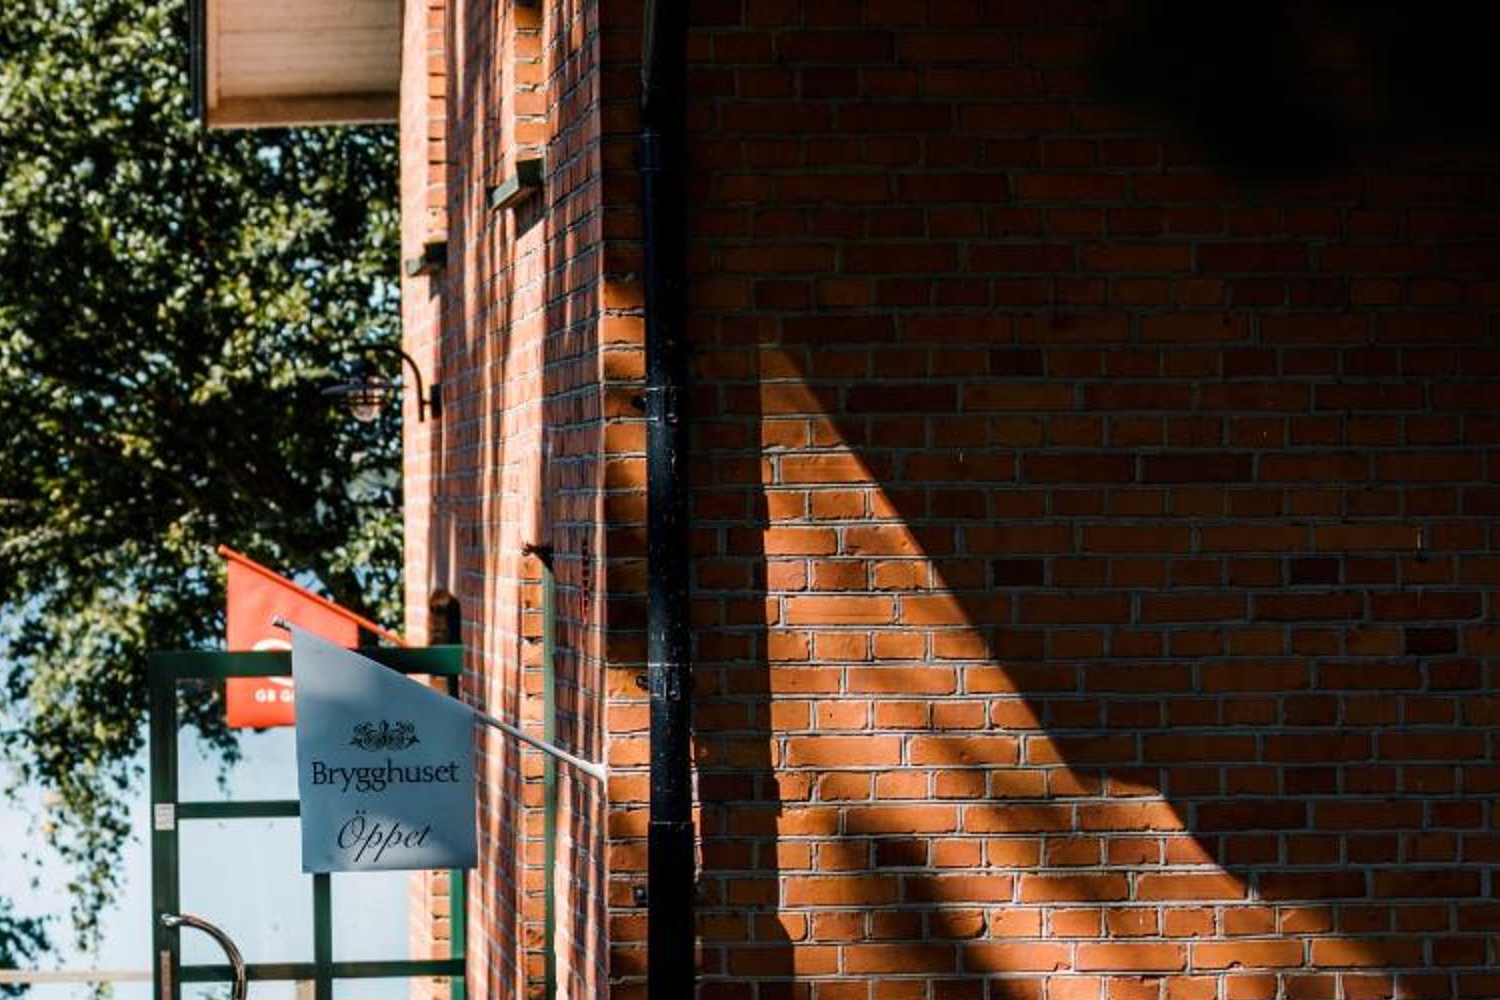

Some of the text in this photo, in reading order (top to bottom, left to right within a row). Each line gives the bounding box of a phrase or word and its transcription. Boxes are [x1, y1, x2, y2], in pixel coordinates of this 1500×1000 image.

[254, 688, 276, 703] GB
[311, 758, 460, 793] Brygghuset
[337, 809, 433, 863] Öppet
